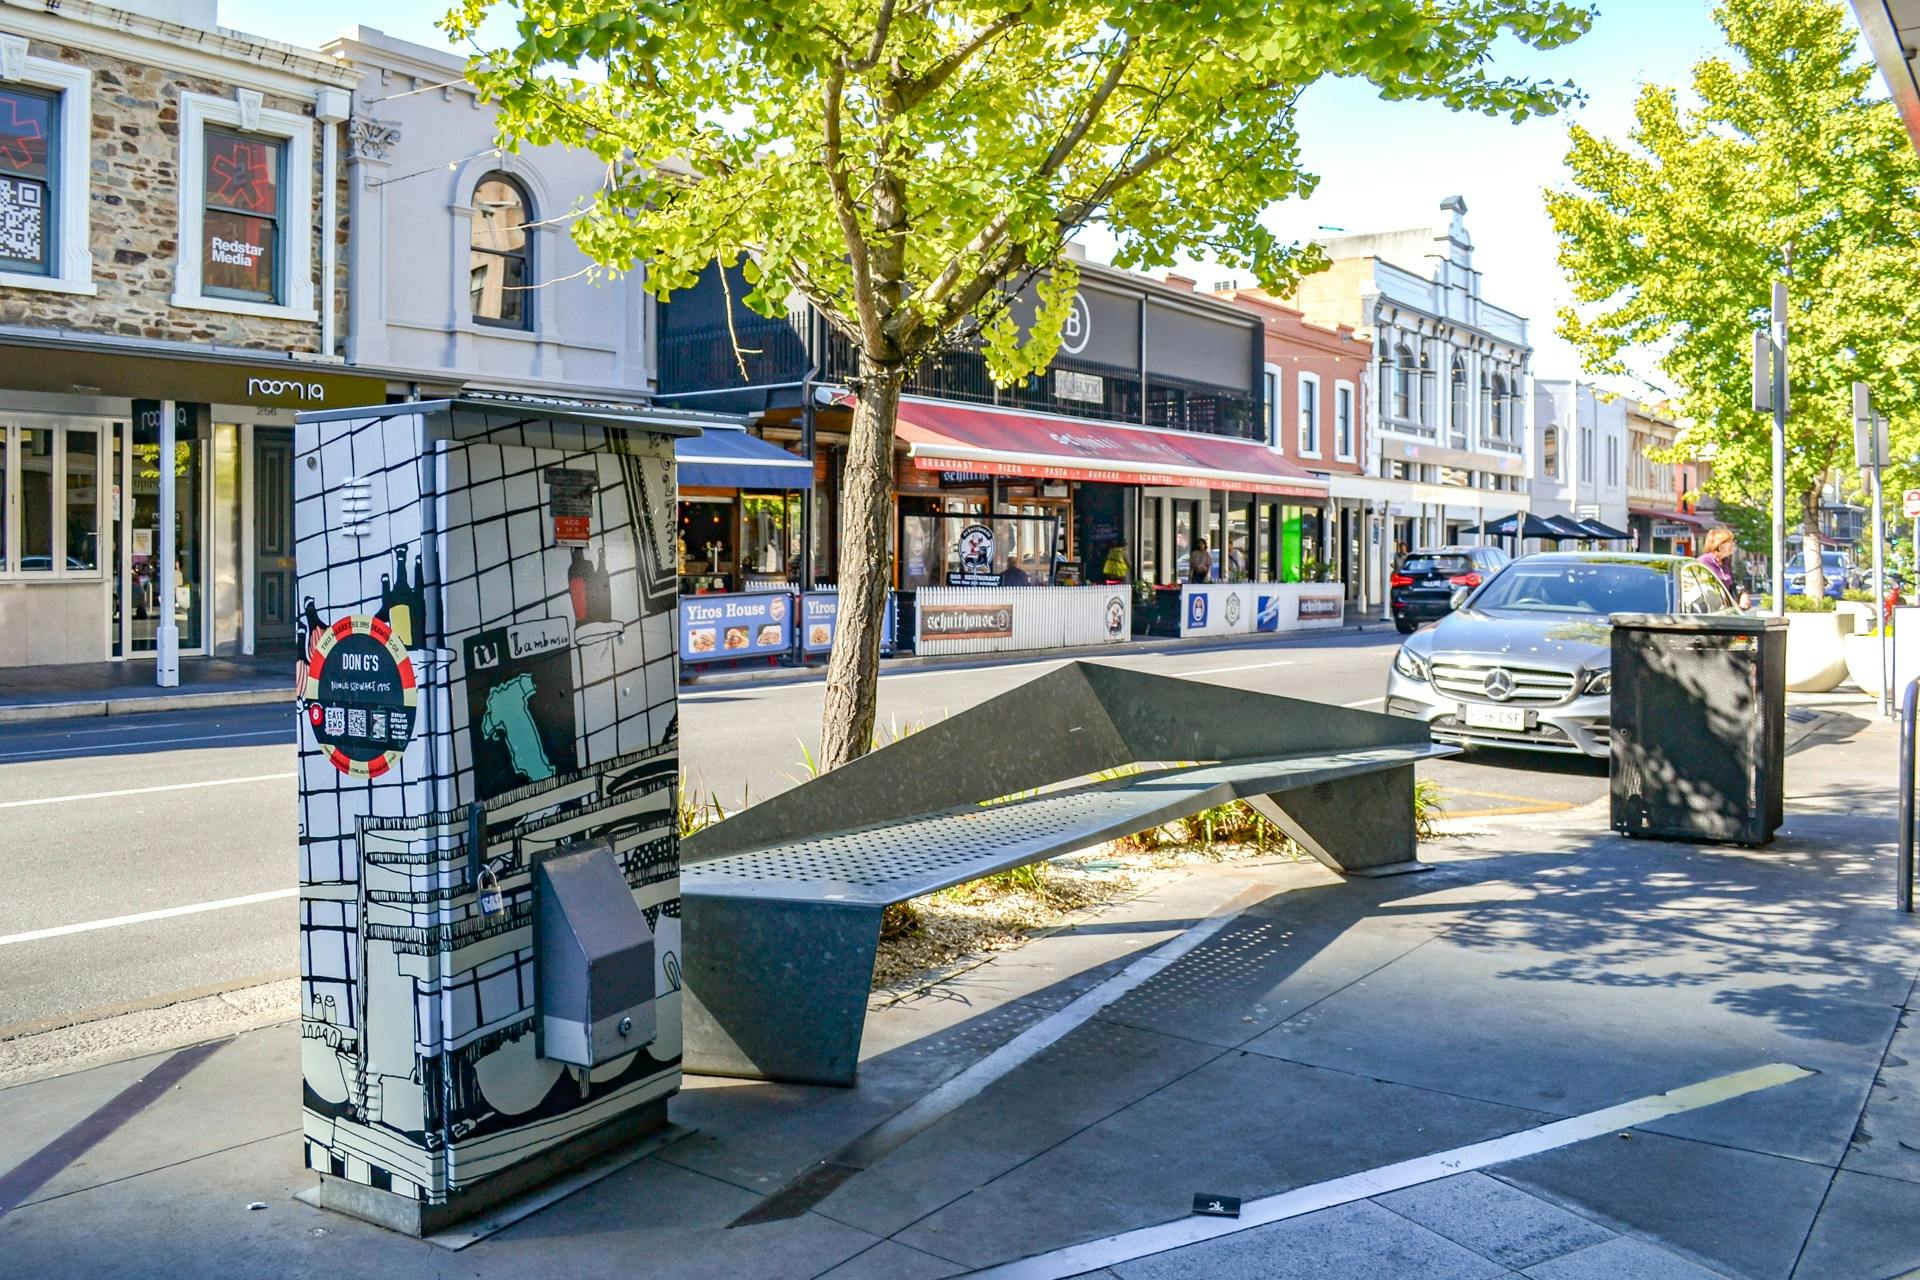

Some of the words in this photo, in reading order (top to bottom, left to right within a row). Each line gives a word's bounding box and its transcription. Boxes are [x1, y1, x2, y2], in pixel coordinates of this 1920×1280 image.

[212, 236, 264, 256] Redstar
[211, 249, 252, 267] Media
[248, 378, 304, 400] room
[308, 384, 324, 401] 19
[257, 406, 277, 416] 256
[141, 410, 161, 431] roo
[921, 458, 973, 470] BREAKFAST
[998, 464, 1022, 473] PIZZA
[1045, 467, 1068, 476] PASTA
[1088, 470, 1120, 480] BURGERS
[1139, 474, 1173, 484] SCHNITZEL
[687, 605, 722, 620] Yiros
[726, 603, 765, 618] House
[807, 601, 836, 615] Yiros
[342, 653, 361, 670] DON
[363, 654, 379, 671] G'S
[313, 708, 320, 720] 8
[328, 710, 344, 720] EAST
[328, 720, 343, 729] END
